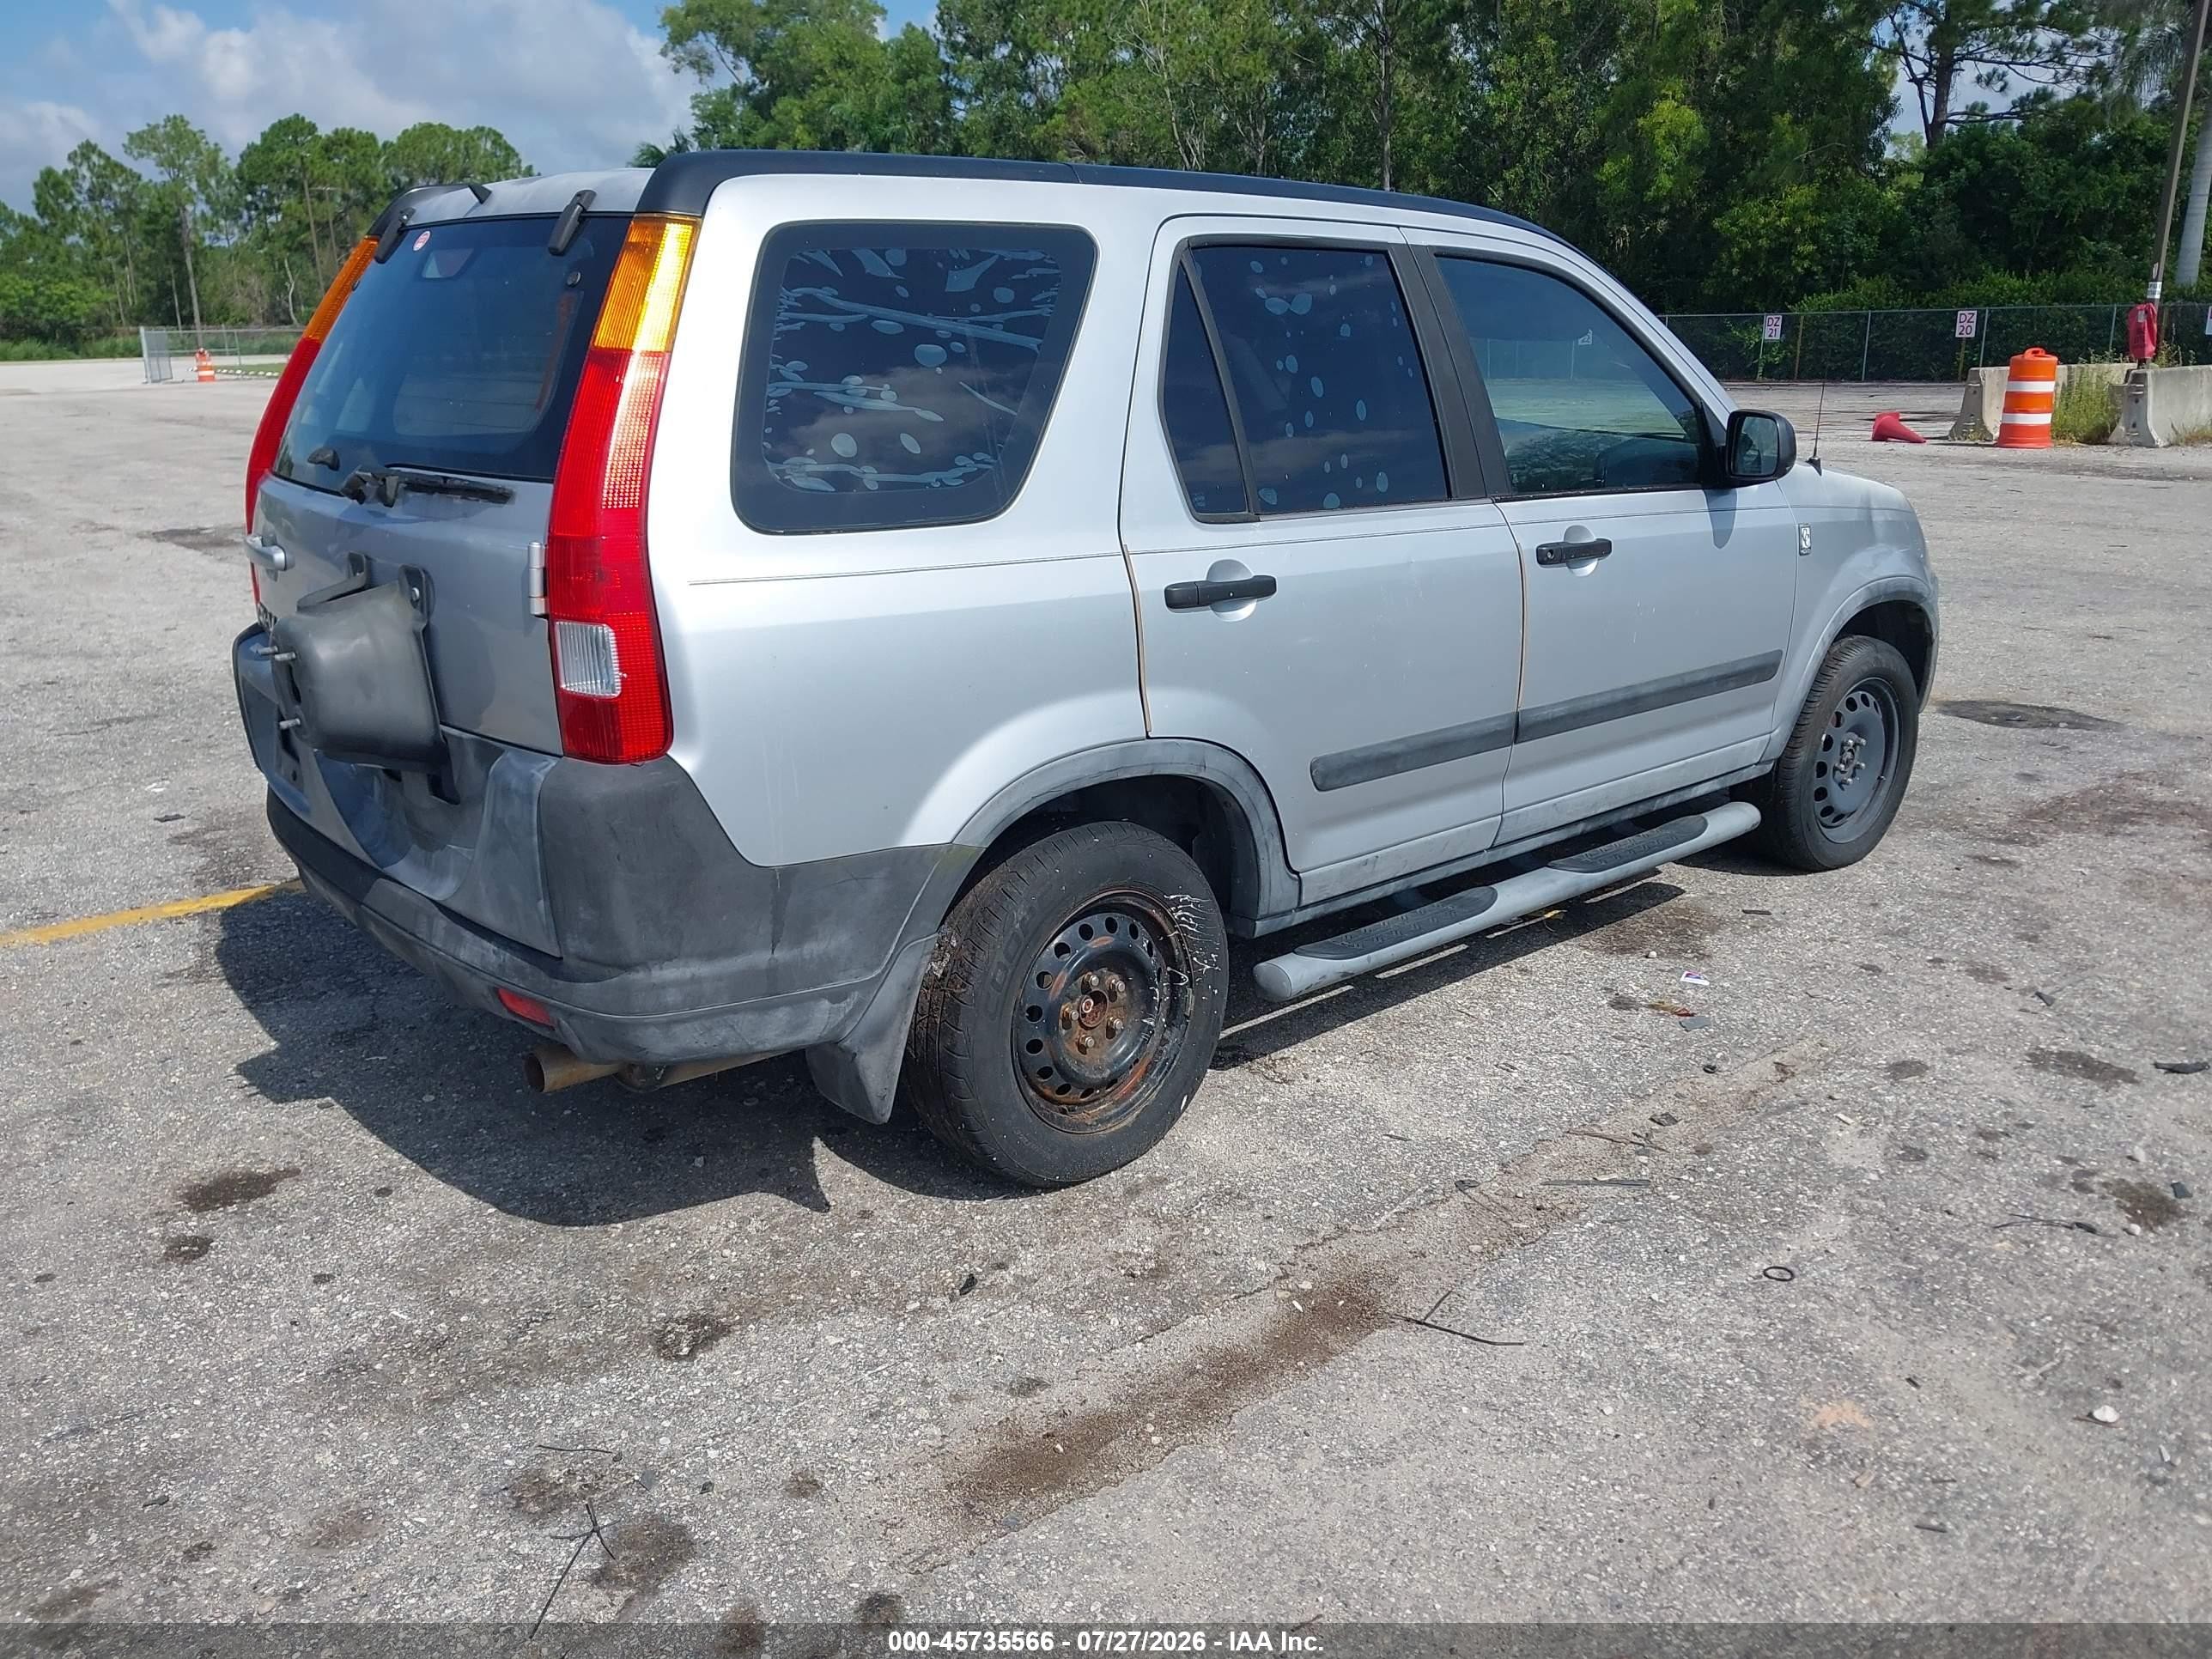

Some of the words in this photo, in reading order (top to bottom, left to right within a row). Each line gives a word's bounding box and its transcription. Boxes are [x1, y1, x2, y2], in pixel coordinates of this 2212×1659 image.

[1767, 316, 1780, 327] DZ
[1959, 313, 1975, 324] DZ
[1768, 328, 1777, 337] 21
[1958, 325, 1972, 336] 20
